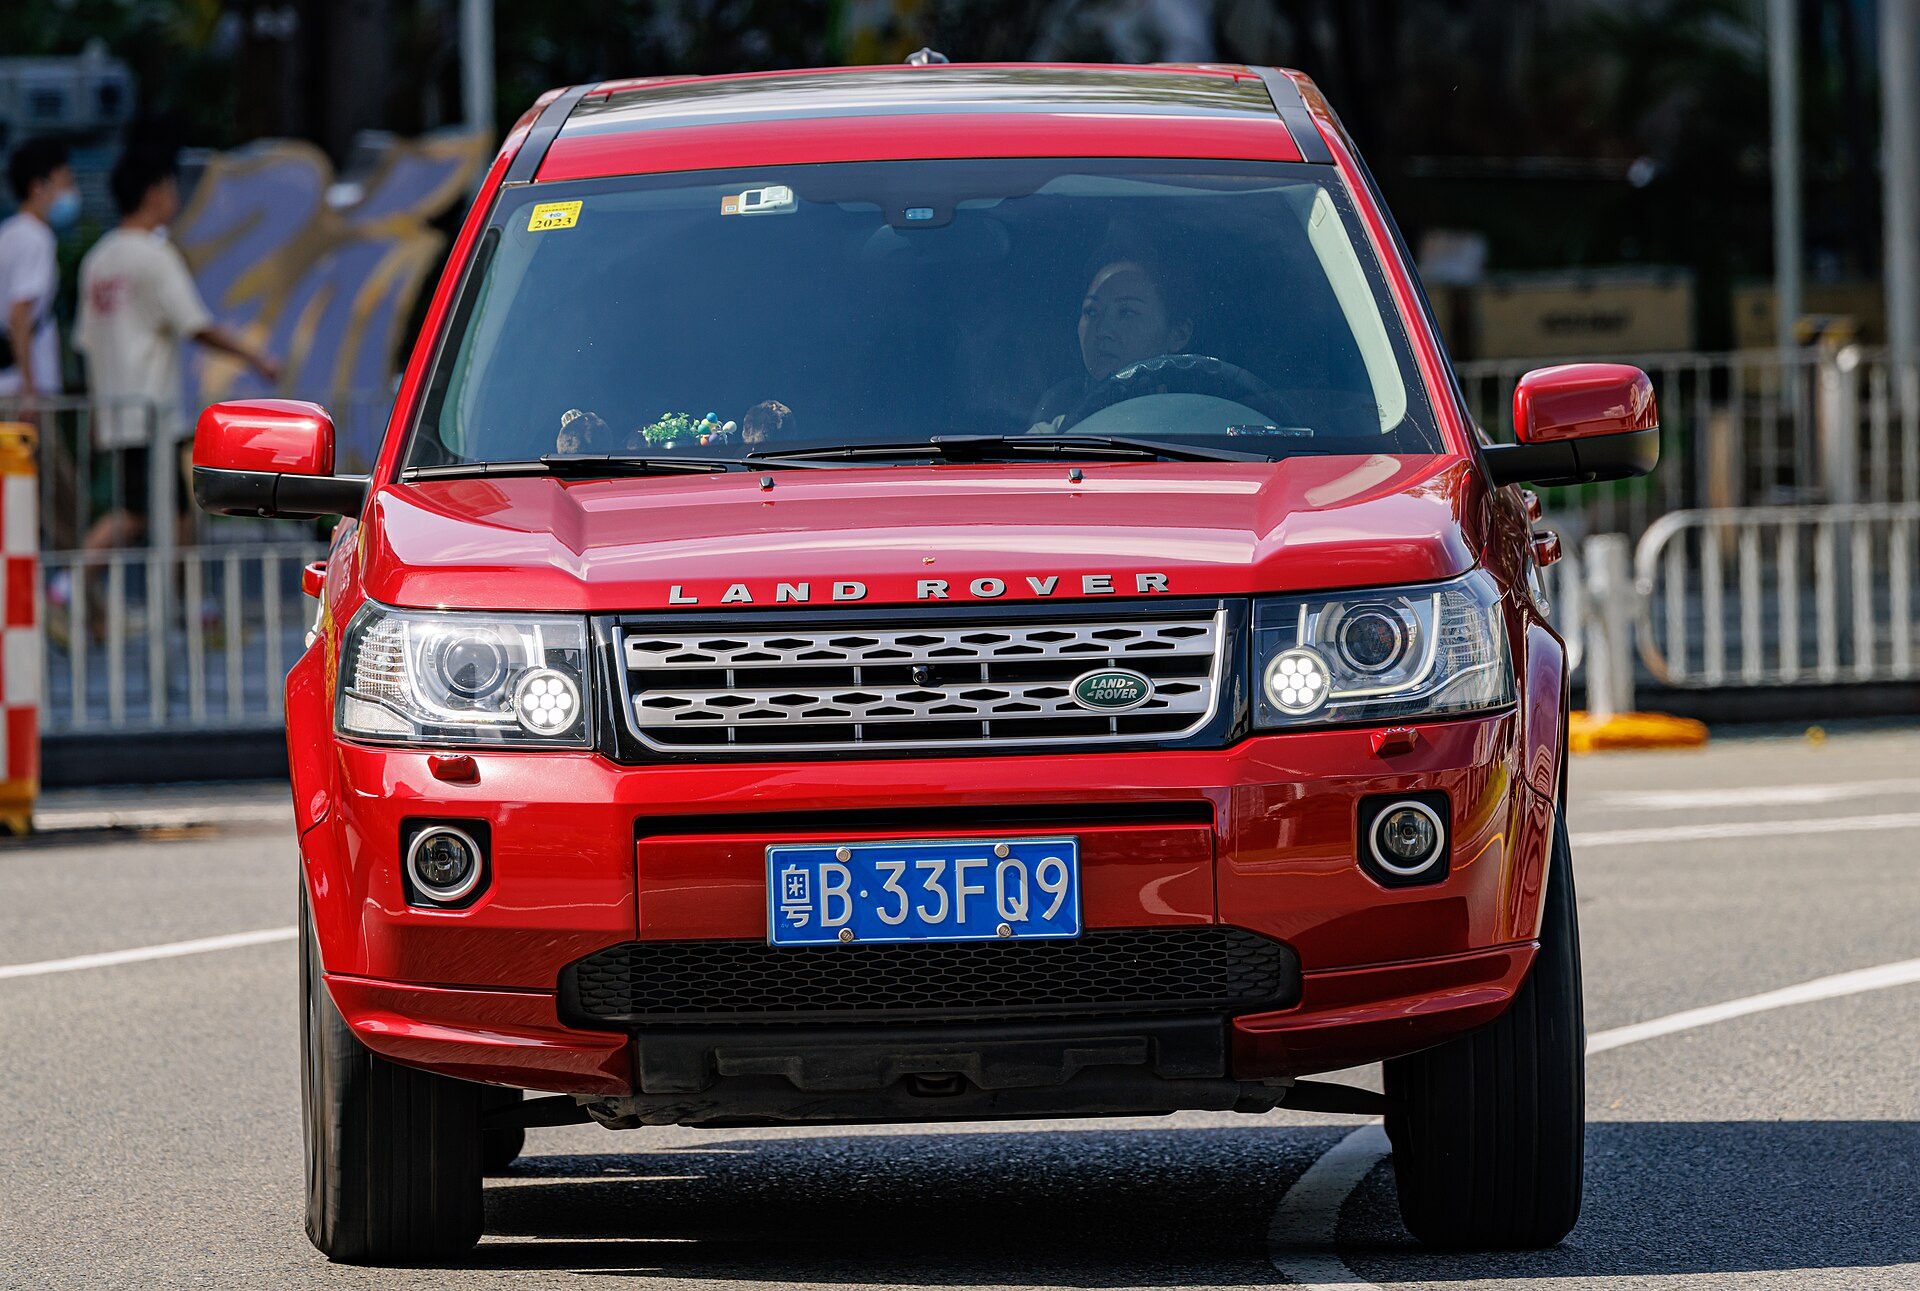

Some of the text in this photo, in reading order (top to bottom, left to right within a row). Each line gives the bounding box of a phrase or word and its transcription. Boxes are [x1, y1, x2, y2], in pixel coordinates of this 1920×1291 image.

[534, 217, 571, 228] 2023
[669, 573, 1169, 604] LAND ROVER
[1091, 678, 1126, 689] LAND
[1095, 688, 1137, 699] ROVER
[780, 856, 1069, 928] 粤B·33FQ9
